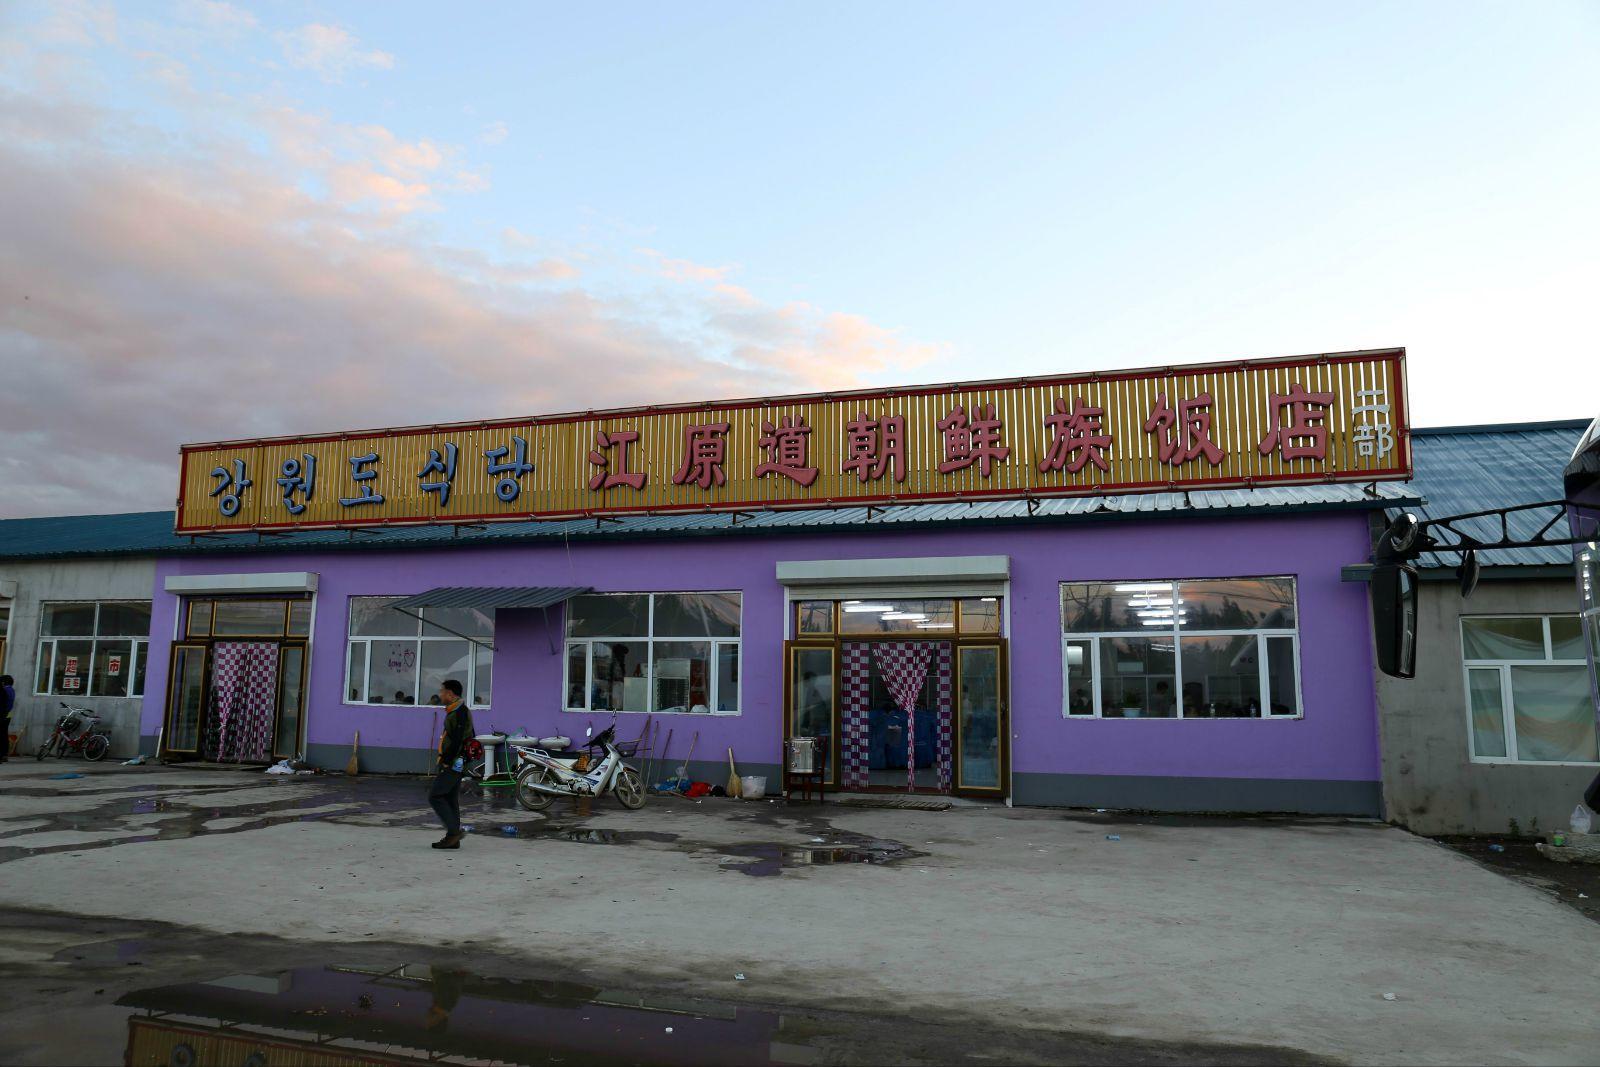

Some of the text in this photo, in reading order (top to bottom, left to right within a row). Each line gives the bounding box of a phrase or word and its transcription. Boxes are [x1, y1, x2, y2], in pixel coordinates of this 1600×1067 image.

[589, 383, 1335, 492] 江原道朝鲜族饭店
[1352, 389, 1394, 459] 二部
[209, 436, 535, 517] 강원도식당
